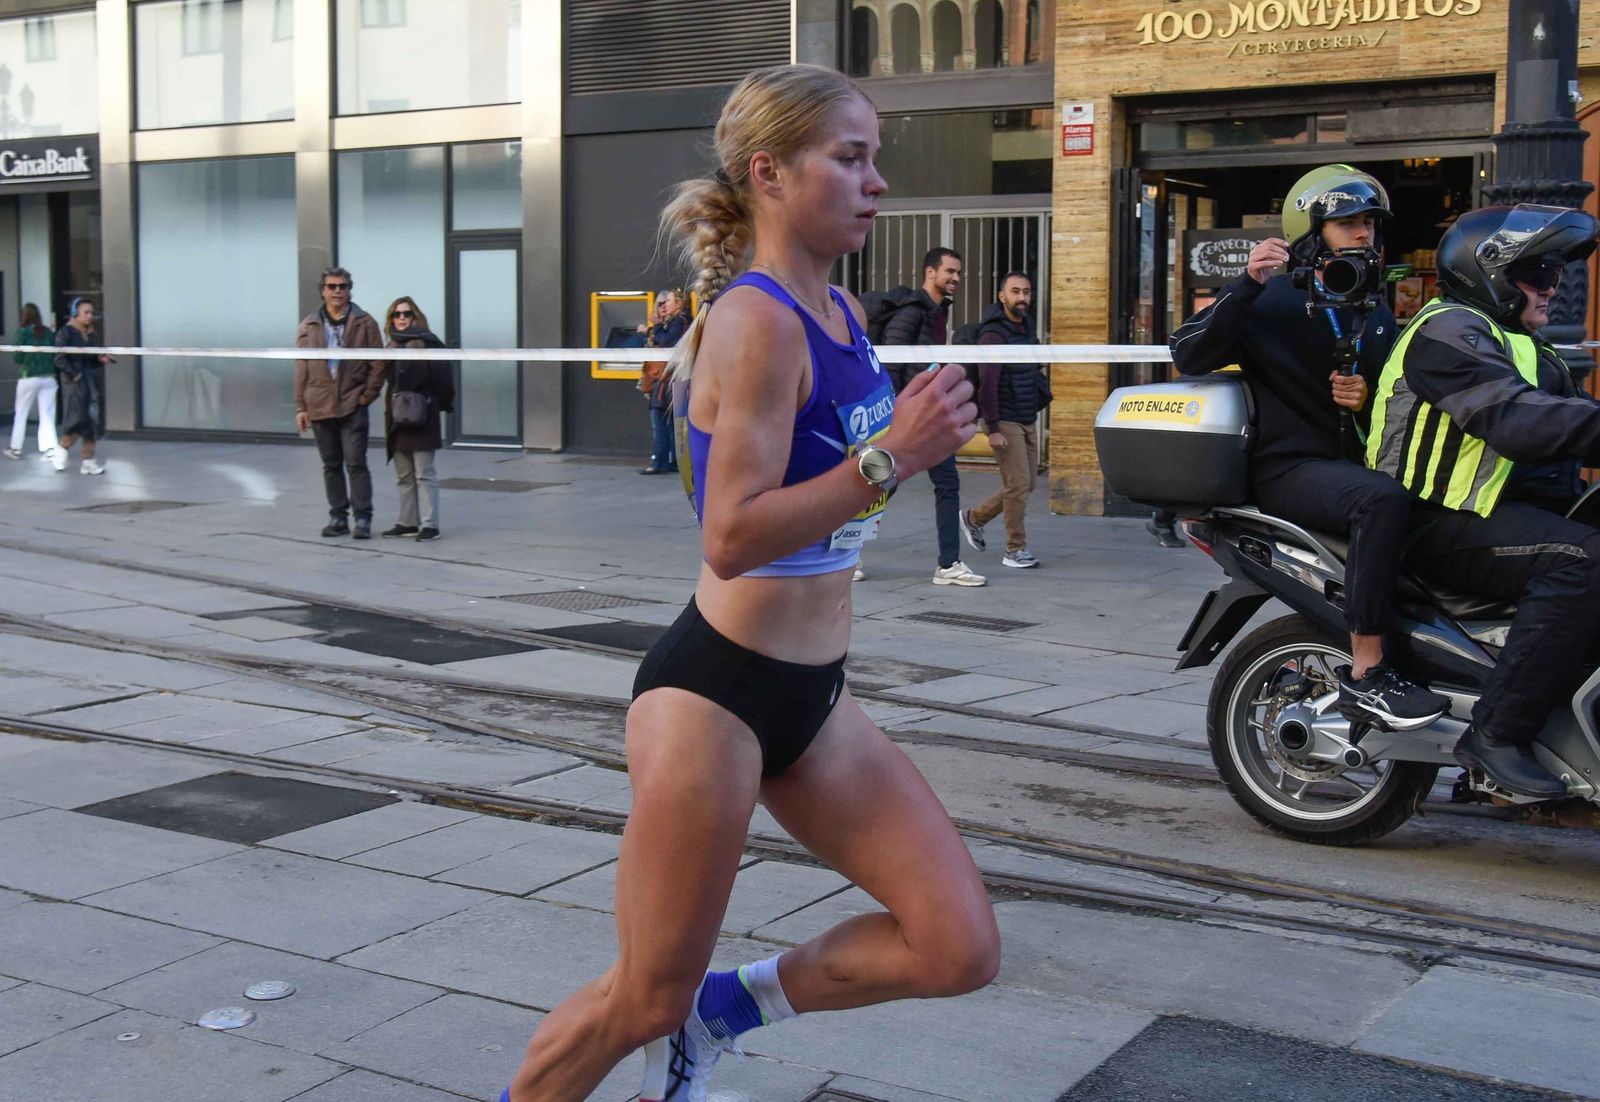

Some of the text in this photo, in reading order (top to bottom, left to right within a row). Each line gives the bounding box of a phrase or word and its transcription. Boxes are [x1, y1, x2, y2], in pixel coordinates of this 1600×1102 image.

[1135, 9, 1213, 46] 100
[0, 146, 91, 177] CaixaBank
[1119, 400, 1184, 414] MOTO ENLACE
